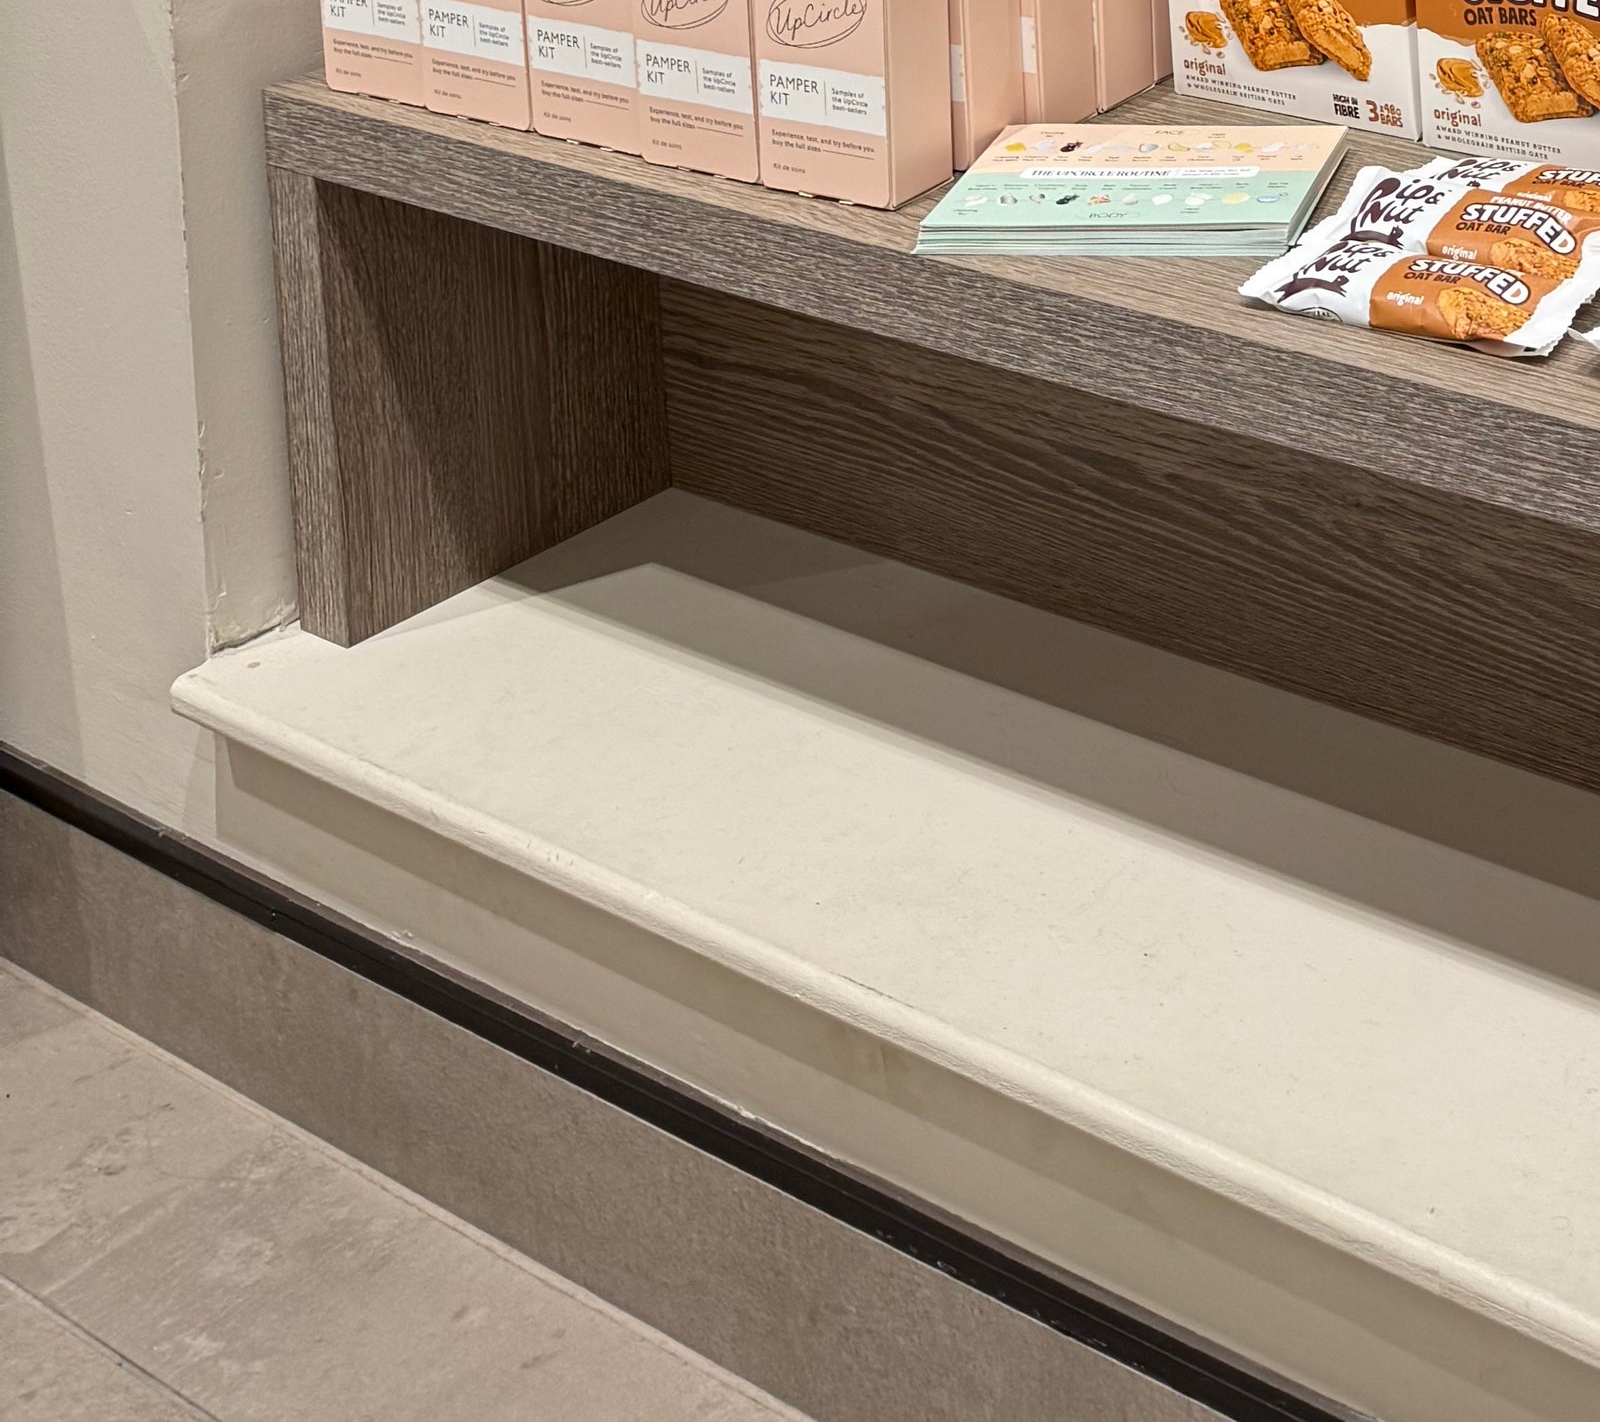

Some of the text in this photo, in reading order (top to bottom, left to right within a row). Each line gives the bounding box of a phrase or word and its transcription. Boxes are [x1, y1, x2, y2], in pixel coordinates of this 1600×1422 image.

[330, 5, 346, 19] KIT
[428, 9, 469, 28] PAMPER
[1464, 7, 1537, 26] OAT BARS
[429, 25, 446, 38] KIT
[537, 29, 580, 49] PAMPER
[538, 45, 555, 60] KIT
[646, 54, 691, 74] PAMPER
[1184, 59, 1226, 76] original
[647, 70, 665, 85] KIT
[769, 73, 819, 94] PAMPER
[770, 90, 790, 106] KIT
[1333, 104, 1361, 120] FIBRE
[1366, 100, 1379, 122] 3
[1433, 107, 1481, 127] original
[1380, 114, 1403, 128] BARS
[1360, 201, 1424, 229] Nut
[1459, 203, 1577, 254] STUFFED
[1441, 245, 1478, 262] original
[1408, 259, 1530, 305] STUFFED
[1386, 290, 1424, 307] original
